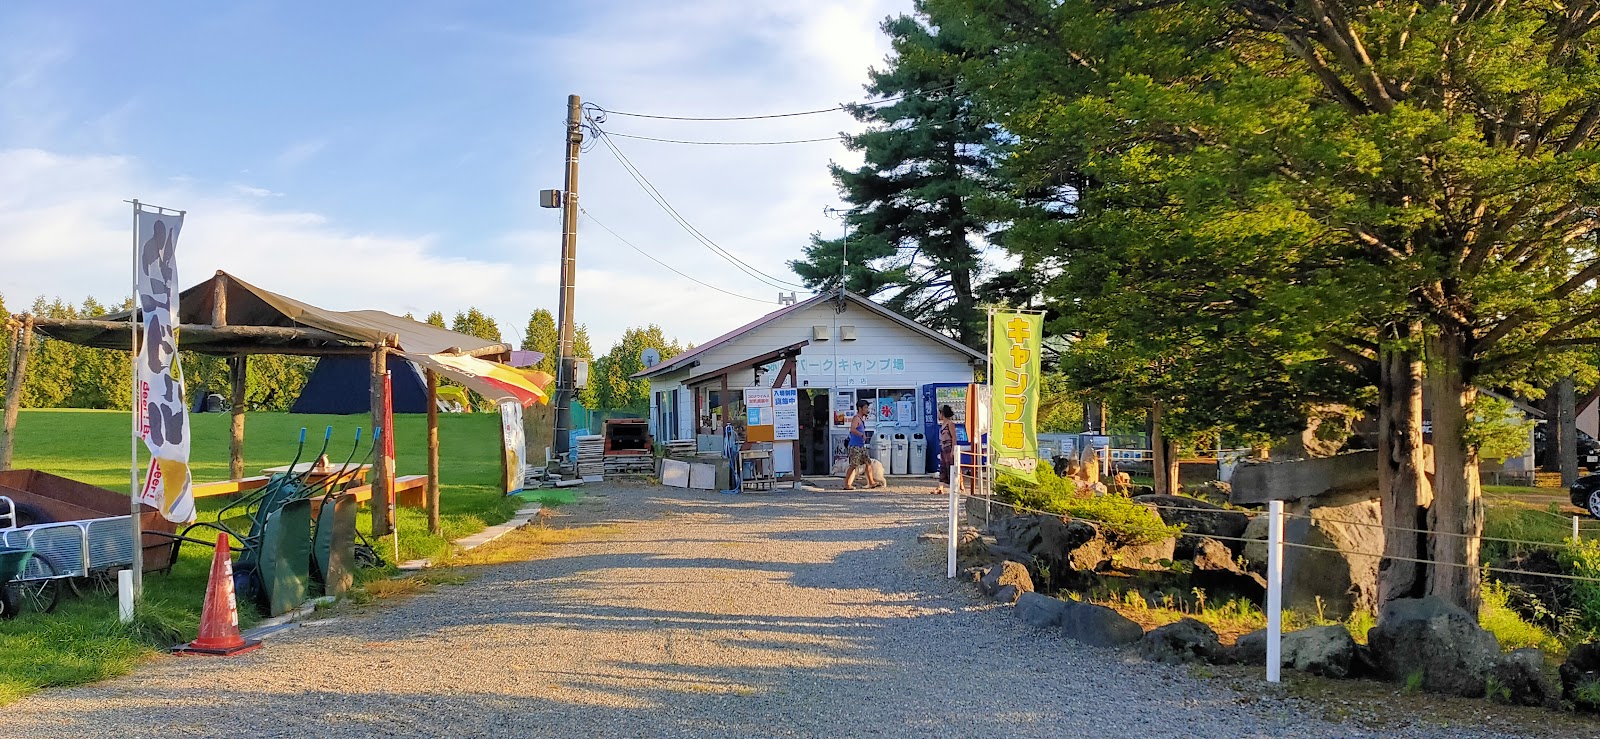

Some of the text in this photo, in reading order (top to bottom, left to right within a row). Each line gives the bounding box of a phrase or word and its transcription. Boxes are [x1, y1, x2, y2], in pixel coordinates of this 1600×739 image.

[881, 405, 893, 418] 氷
[1001, 317, 1031, 449] キャンプ場
